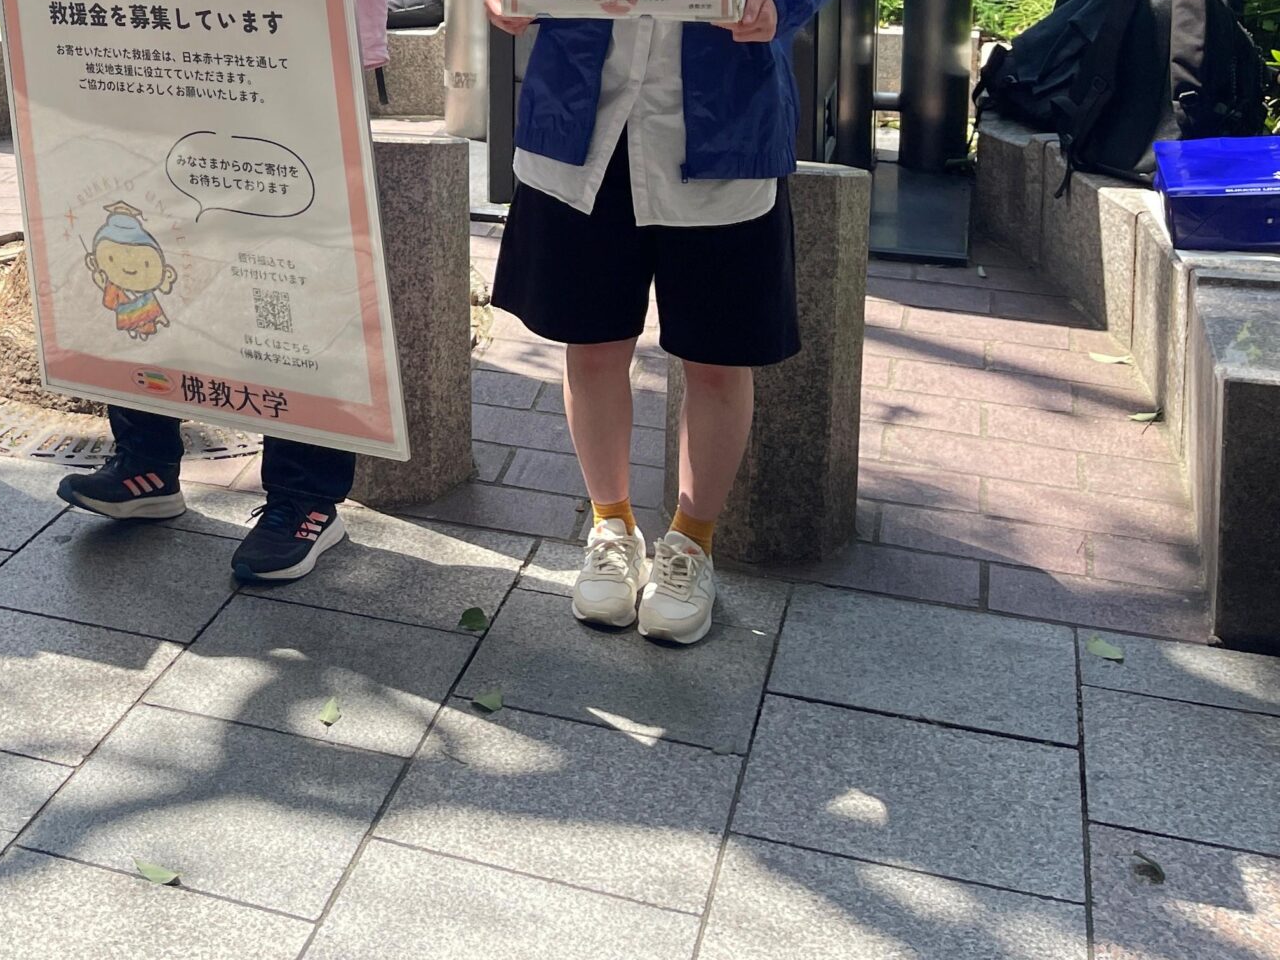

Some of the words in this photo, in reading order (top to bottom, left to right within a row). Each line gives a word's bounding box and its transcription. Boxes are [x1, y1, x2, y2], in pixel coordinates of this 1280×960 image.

[48, 0, 284, 35] 救援金を募集しています
[176, 154, 300, 179] みなさまからのご寄付を
[189, 173, 290, 195] お待ちしております
[181, 374, 289, 419] 佛教大学
